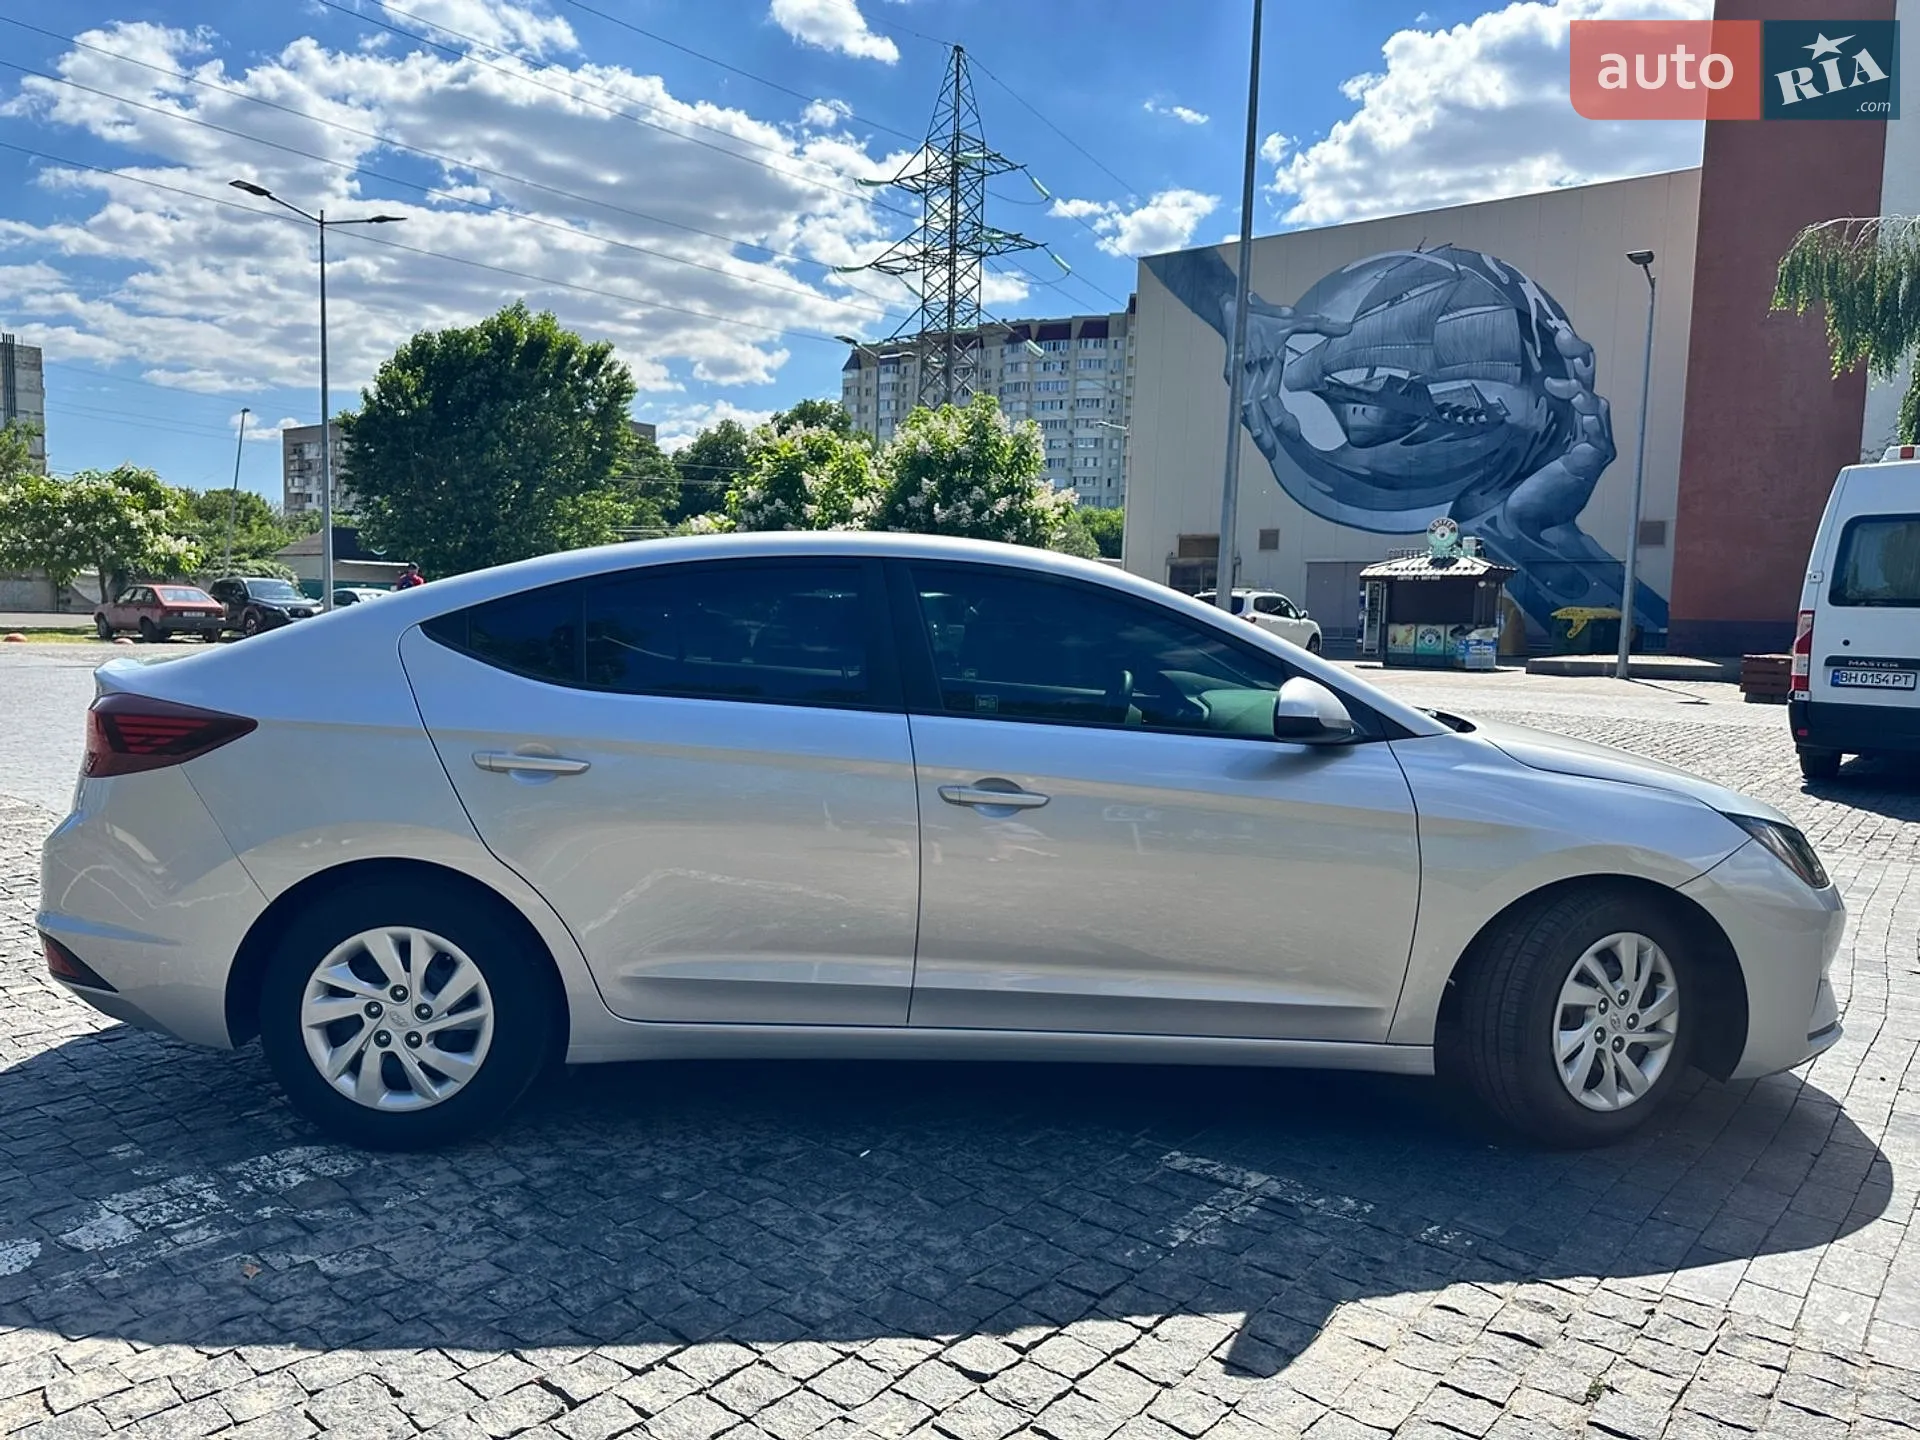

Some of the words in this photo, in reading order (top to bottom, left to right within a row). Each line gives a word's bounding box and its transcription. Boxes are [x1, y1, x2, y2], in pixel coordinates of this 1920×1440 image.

[1840, 672, 1858, 683] BH
[1860, 673, 1889, 684] 0154
[1892, 674, 1911, 686] PT
